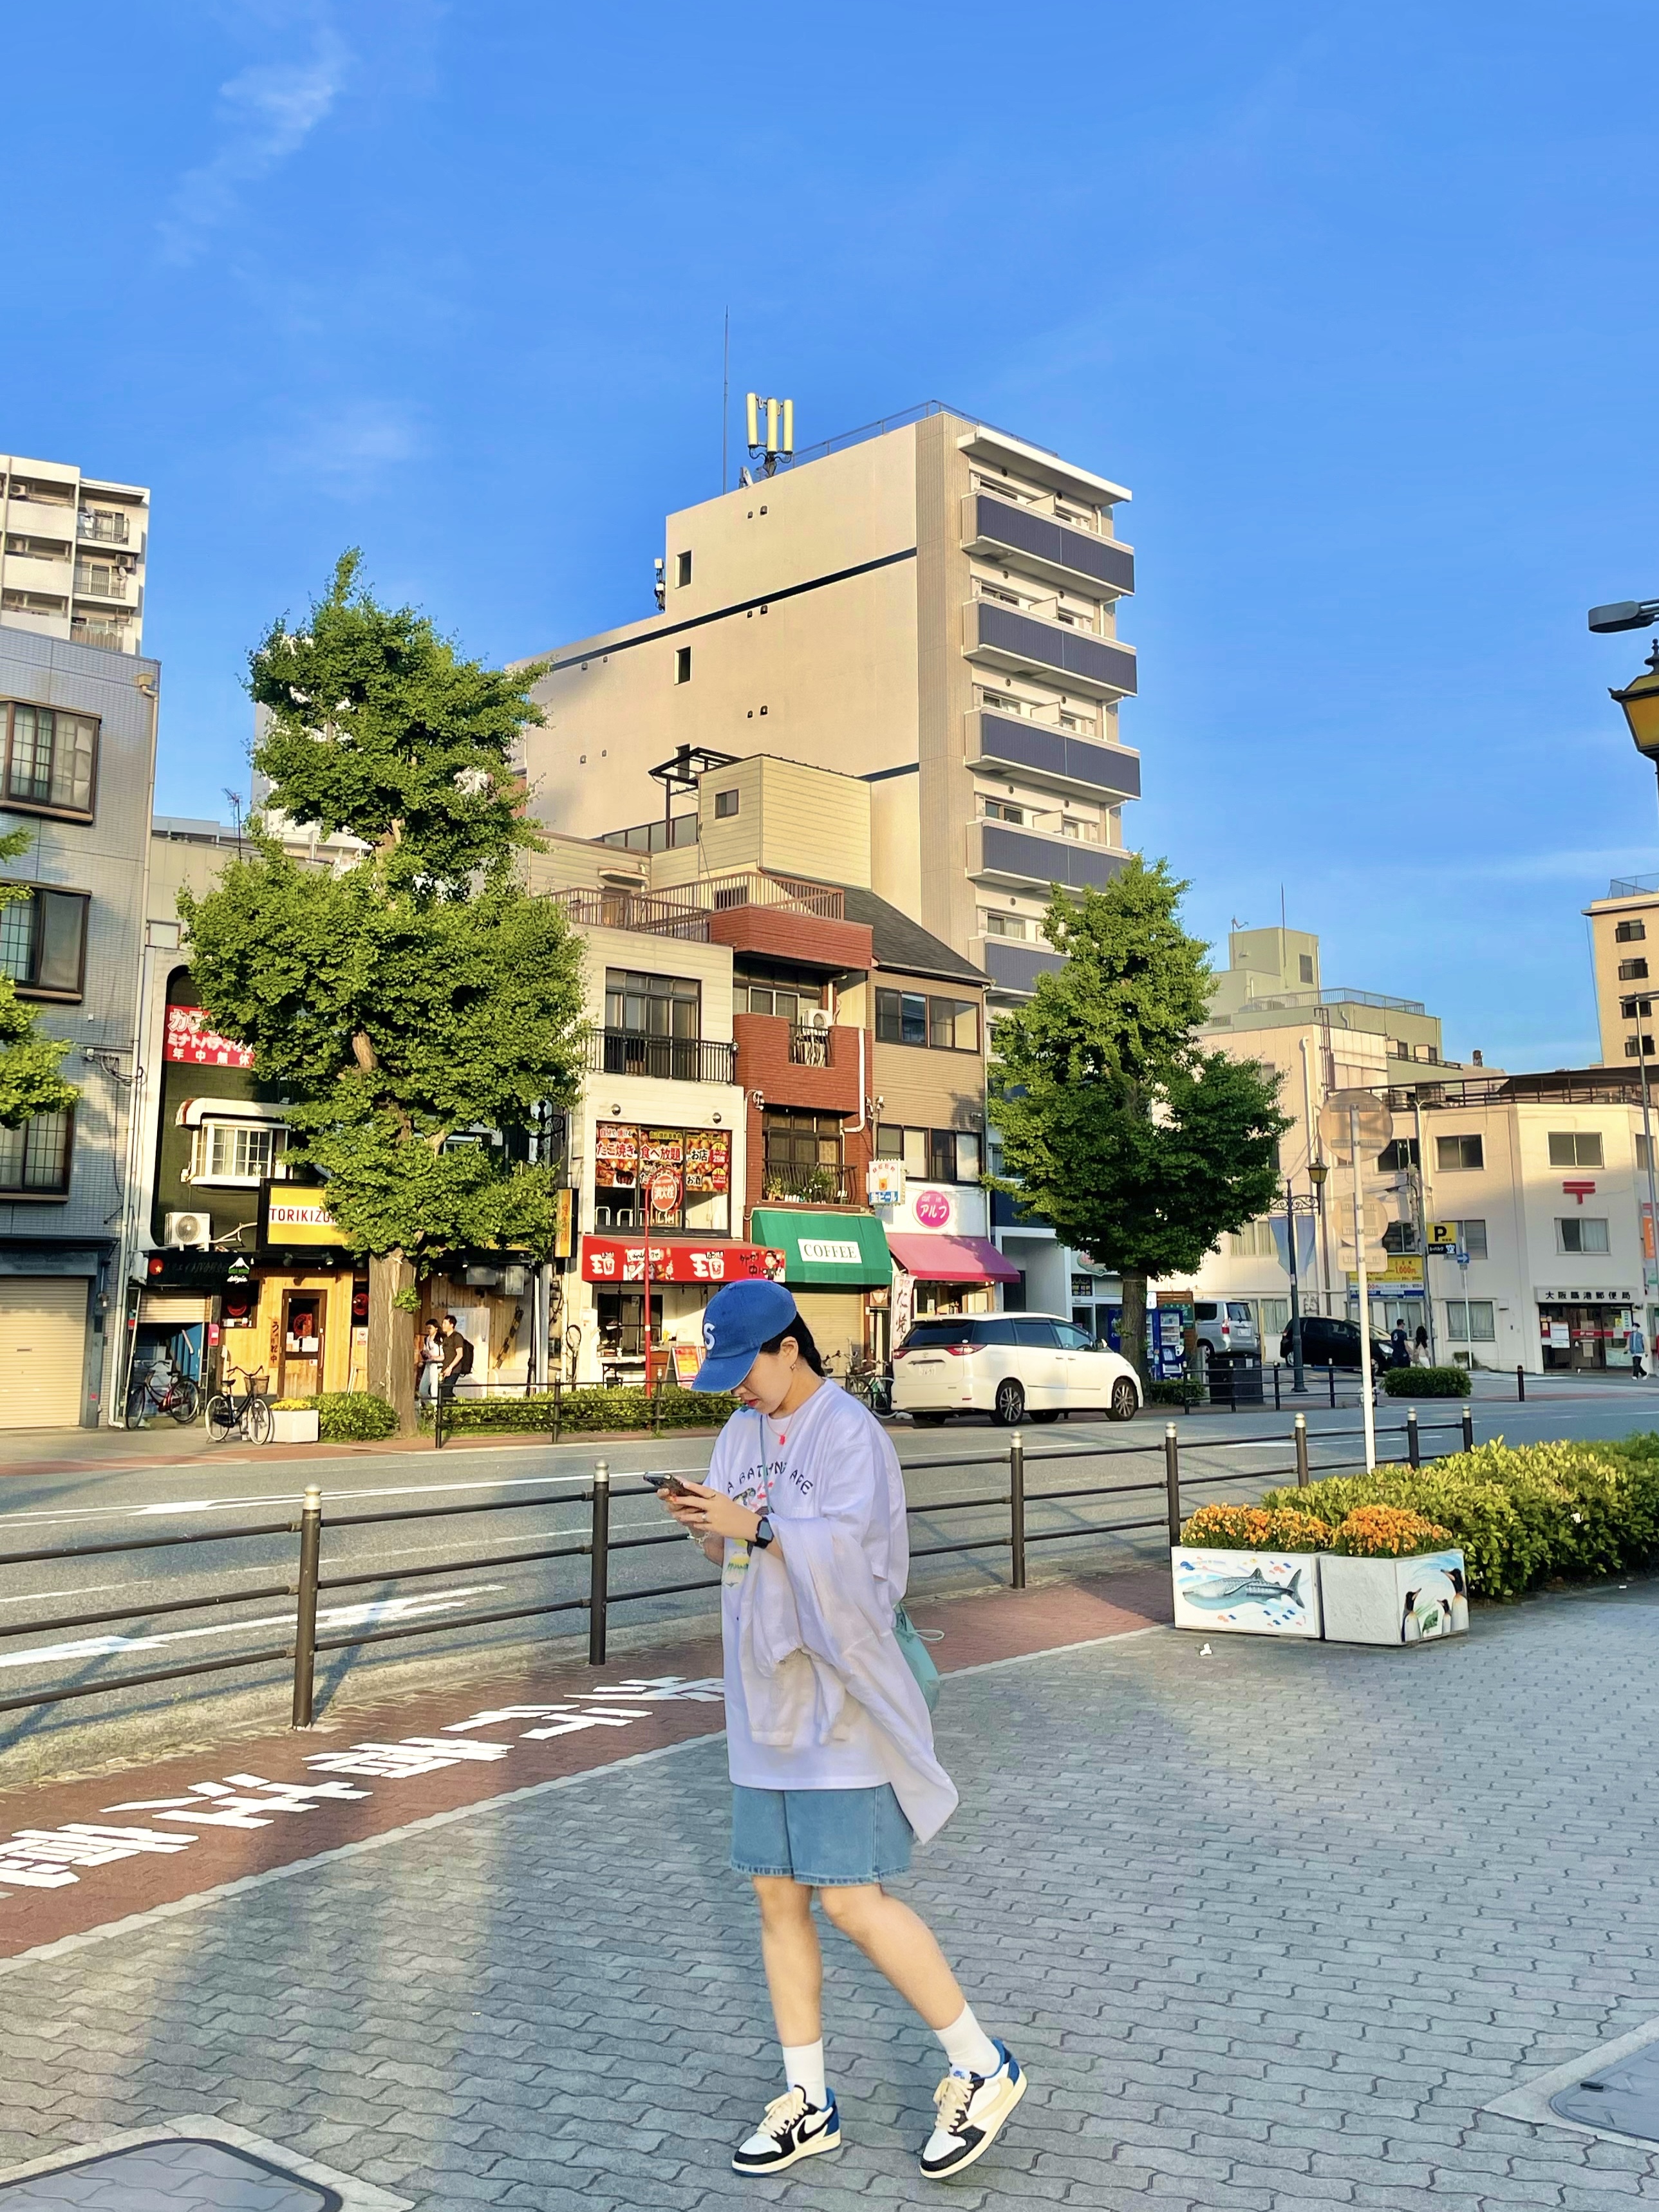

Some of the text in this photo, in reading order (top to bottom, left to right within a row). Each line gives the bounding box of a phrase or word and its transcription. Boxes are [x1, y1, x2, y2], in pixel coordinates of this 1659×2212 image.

[173, 1047, 250, 1066] 年中無休
[596, 1142, 635, 1158] たこ焼き
[653, 1185, 675, 1200] 消火栓
[870, 1192, 898, 1204] 生ビール
[269, 1209, 336, 1223] TORIKIZO
[919, 1204, 947, 1219] アルフ
[1434, 1226, 1447, 1242] P
[803, 1243, 858, 1259] COFFEE
[704, 1323, 716, 1351] S
[727, 1481, 735, 1494] A
